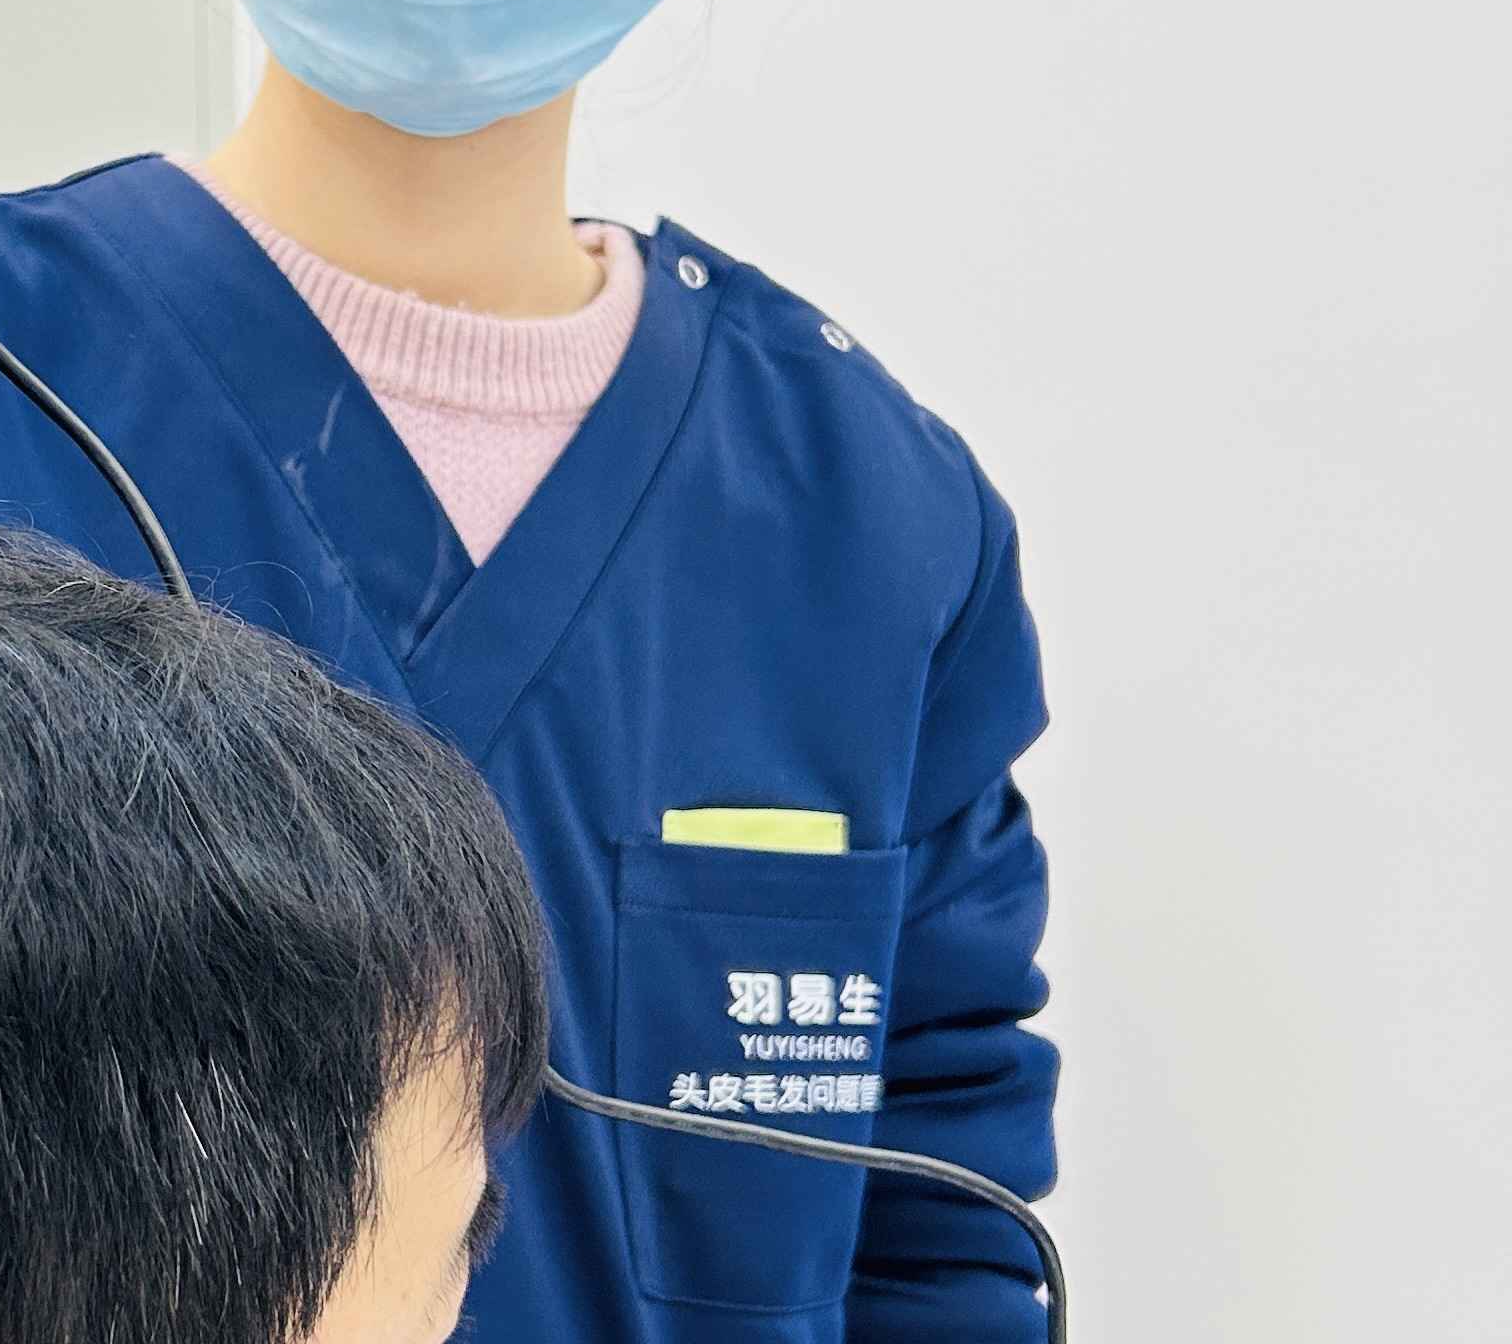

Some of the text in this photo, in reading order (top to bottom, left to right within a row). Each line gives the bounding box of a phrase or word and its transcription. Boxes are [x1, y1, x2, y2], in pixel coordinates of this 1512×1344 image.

[727, 971, 882, 1025] 羽易生
[739, 1034, 870, 1061] YUYISHENG
